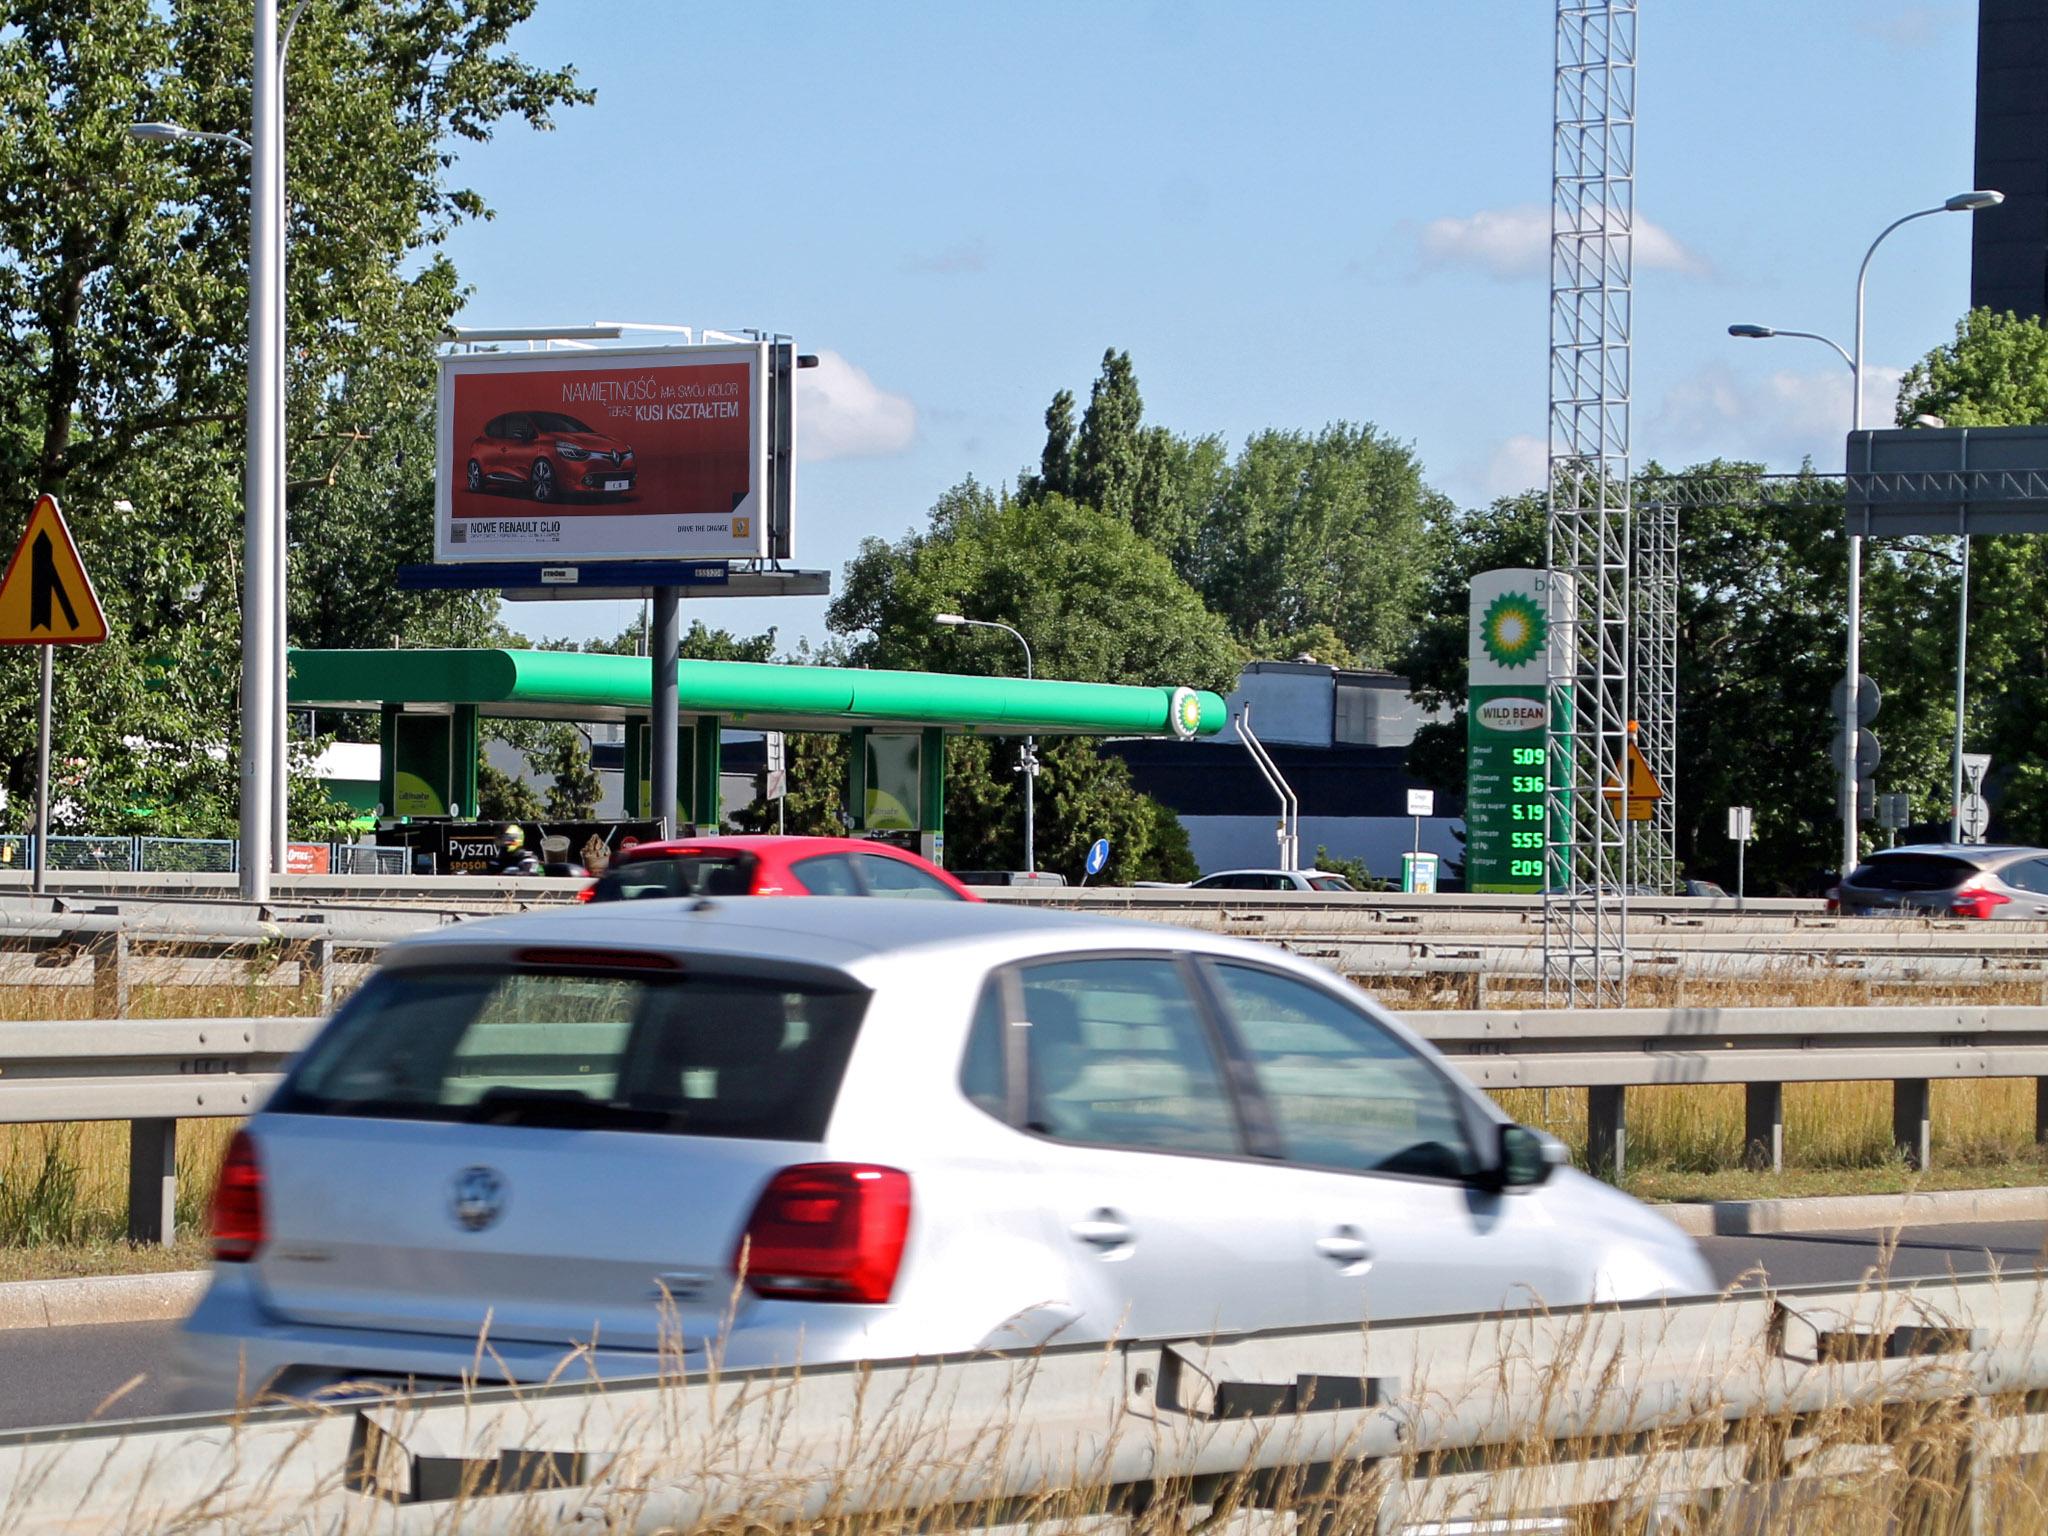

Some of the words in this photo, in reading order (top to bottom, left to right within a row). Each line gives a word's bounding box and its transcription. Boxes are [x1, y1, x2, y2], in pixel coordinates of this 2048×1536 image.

[562, 376, 657, 406] NAMIĘTNOŚĆ
[660, 386, 676, 399] MA
[678, 382, 705, 399] SWÓJ
[707, 382, 739, 397] KOLOR
[608, 405, 633, 417] TERAZ
[635, 404, 663, 421] KUSI
[667, 401, 739, 420] KSZTAŁTEM
[470, 521, 497, 533] NOWE
[499, 521, 538, 533] RENAULT
[540, 520, 560, 532] CLIO
[677, 525, 694, 533] DRIVE
[695, 524, 705, 532] THE
[706, 524, 728, 532] CHANGE
[1483, 707, 1510, 719] WILD
[1513, 707, 1544, 719] BEAN
[1472, 786, 1492, 794] Diesel
